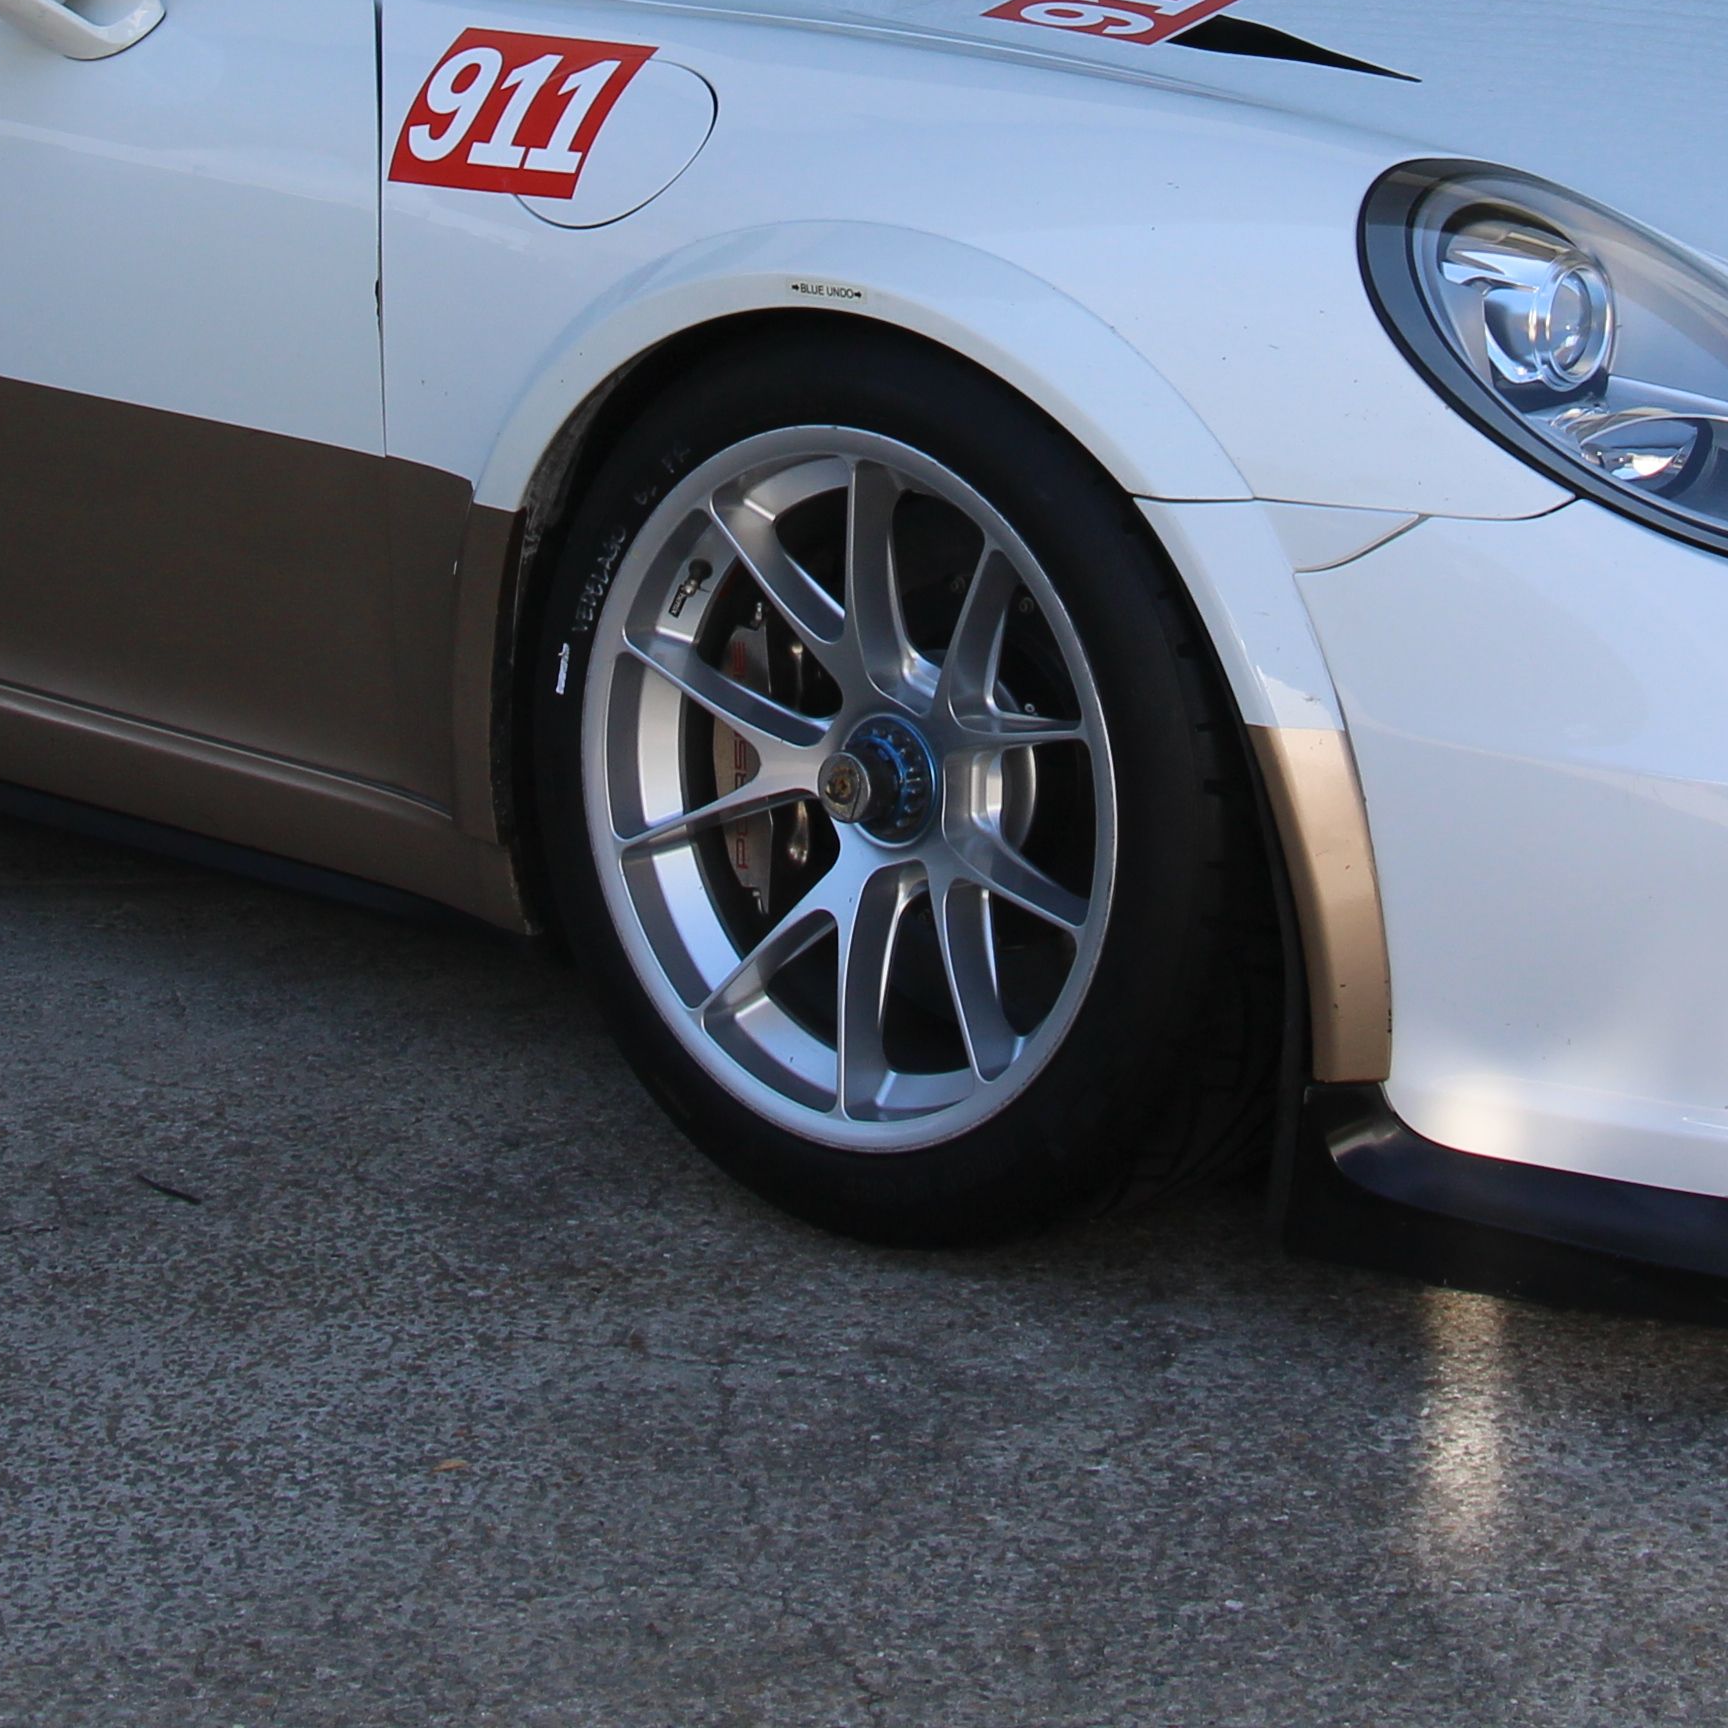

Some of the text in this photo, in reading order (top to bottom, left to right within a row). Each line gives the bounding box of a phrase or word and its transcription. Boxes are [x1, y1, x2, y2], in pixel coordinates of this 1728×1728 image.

[408, 46, 621, 174] 911
[800, 283, 854, 299] BLUE UNDO
